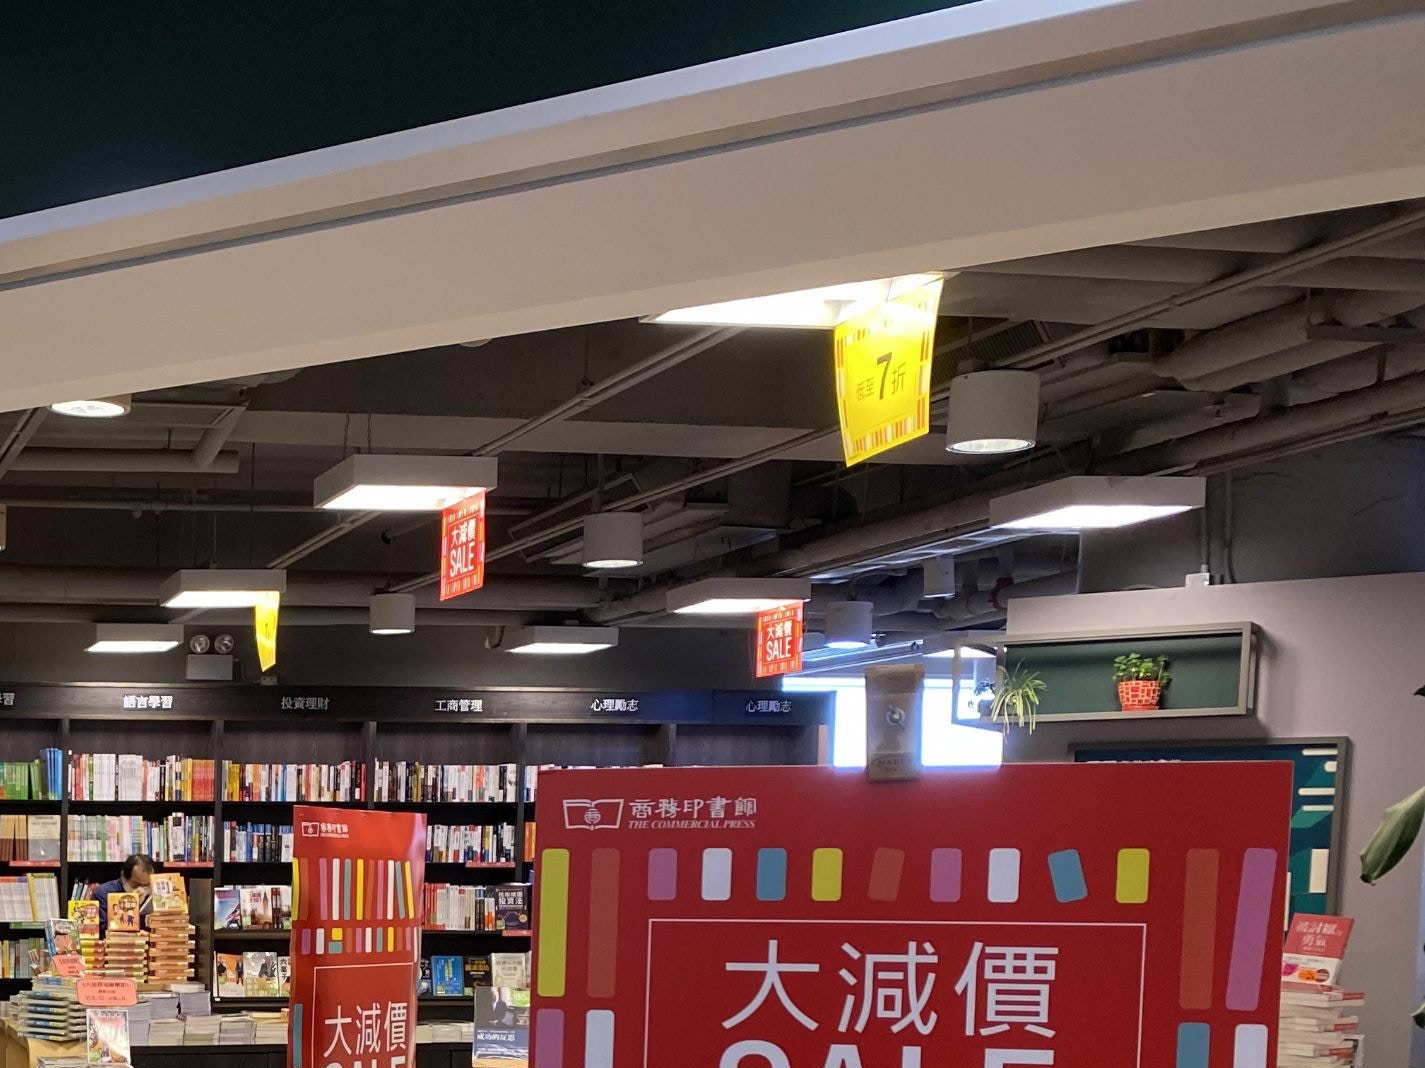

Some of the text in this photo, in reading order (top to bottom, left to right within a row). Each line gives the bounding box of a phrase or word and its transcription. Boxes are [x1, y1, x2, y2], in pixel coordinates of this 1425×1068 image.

[449, 541, 476, 578] SALE
[765, 636, 792, 662] SALE
[123, 695, 174, 709] 語言學習
[280, 696, 330, 710] 投資理財
[434, 699, 483, 713] 工商管理
[629, 796, 757, 818] 商務印書館
[628, 819, 756, 829] THE COMMERCIAL PRESS
[721, 940, 1059, 1038] 大減價
[324, 1001, 408, 1057] 大減價
